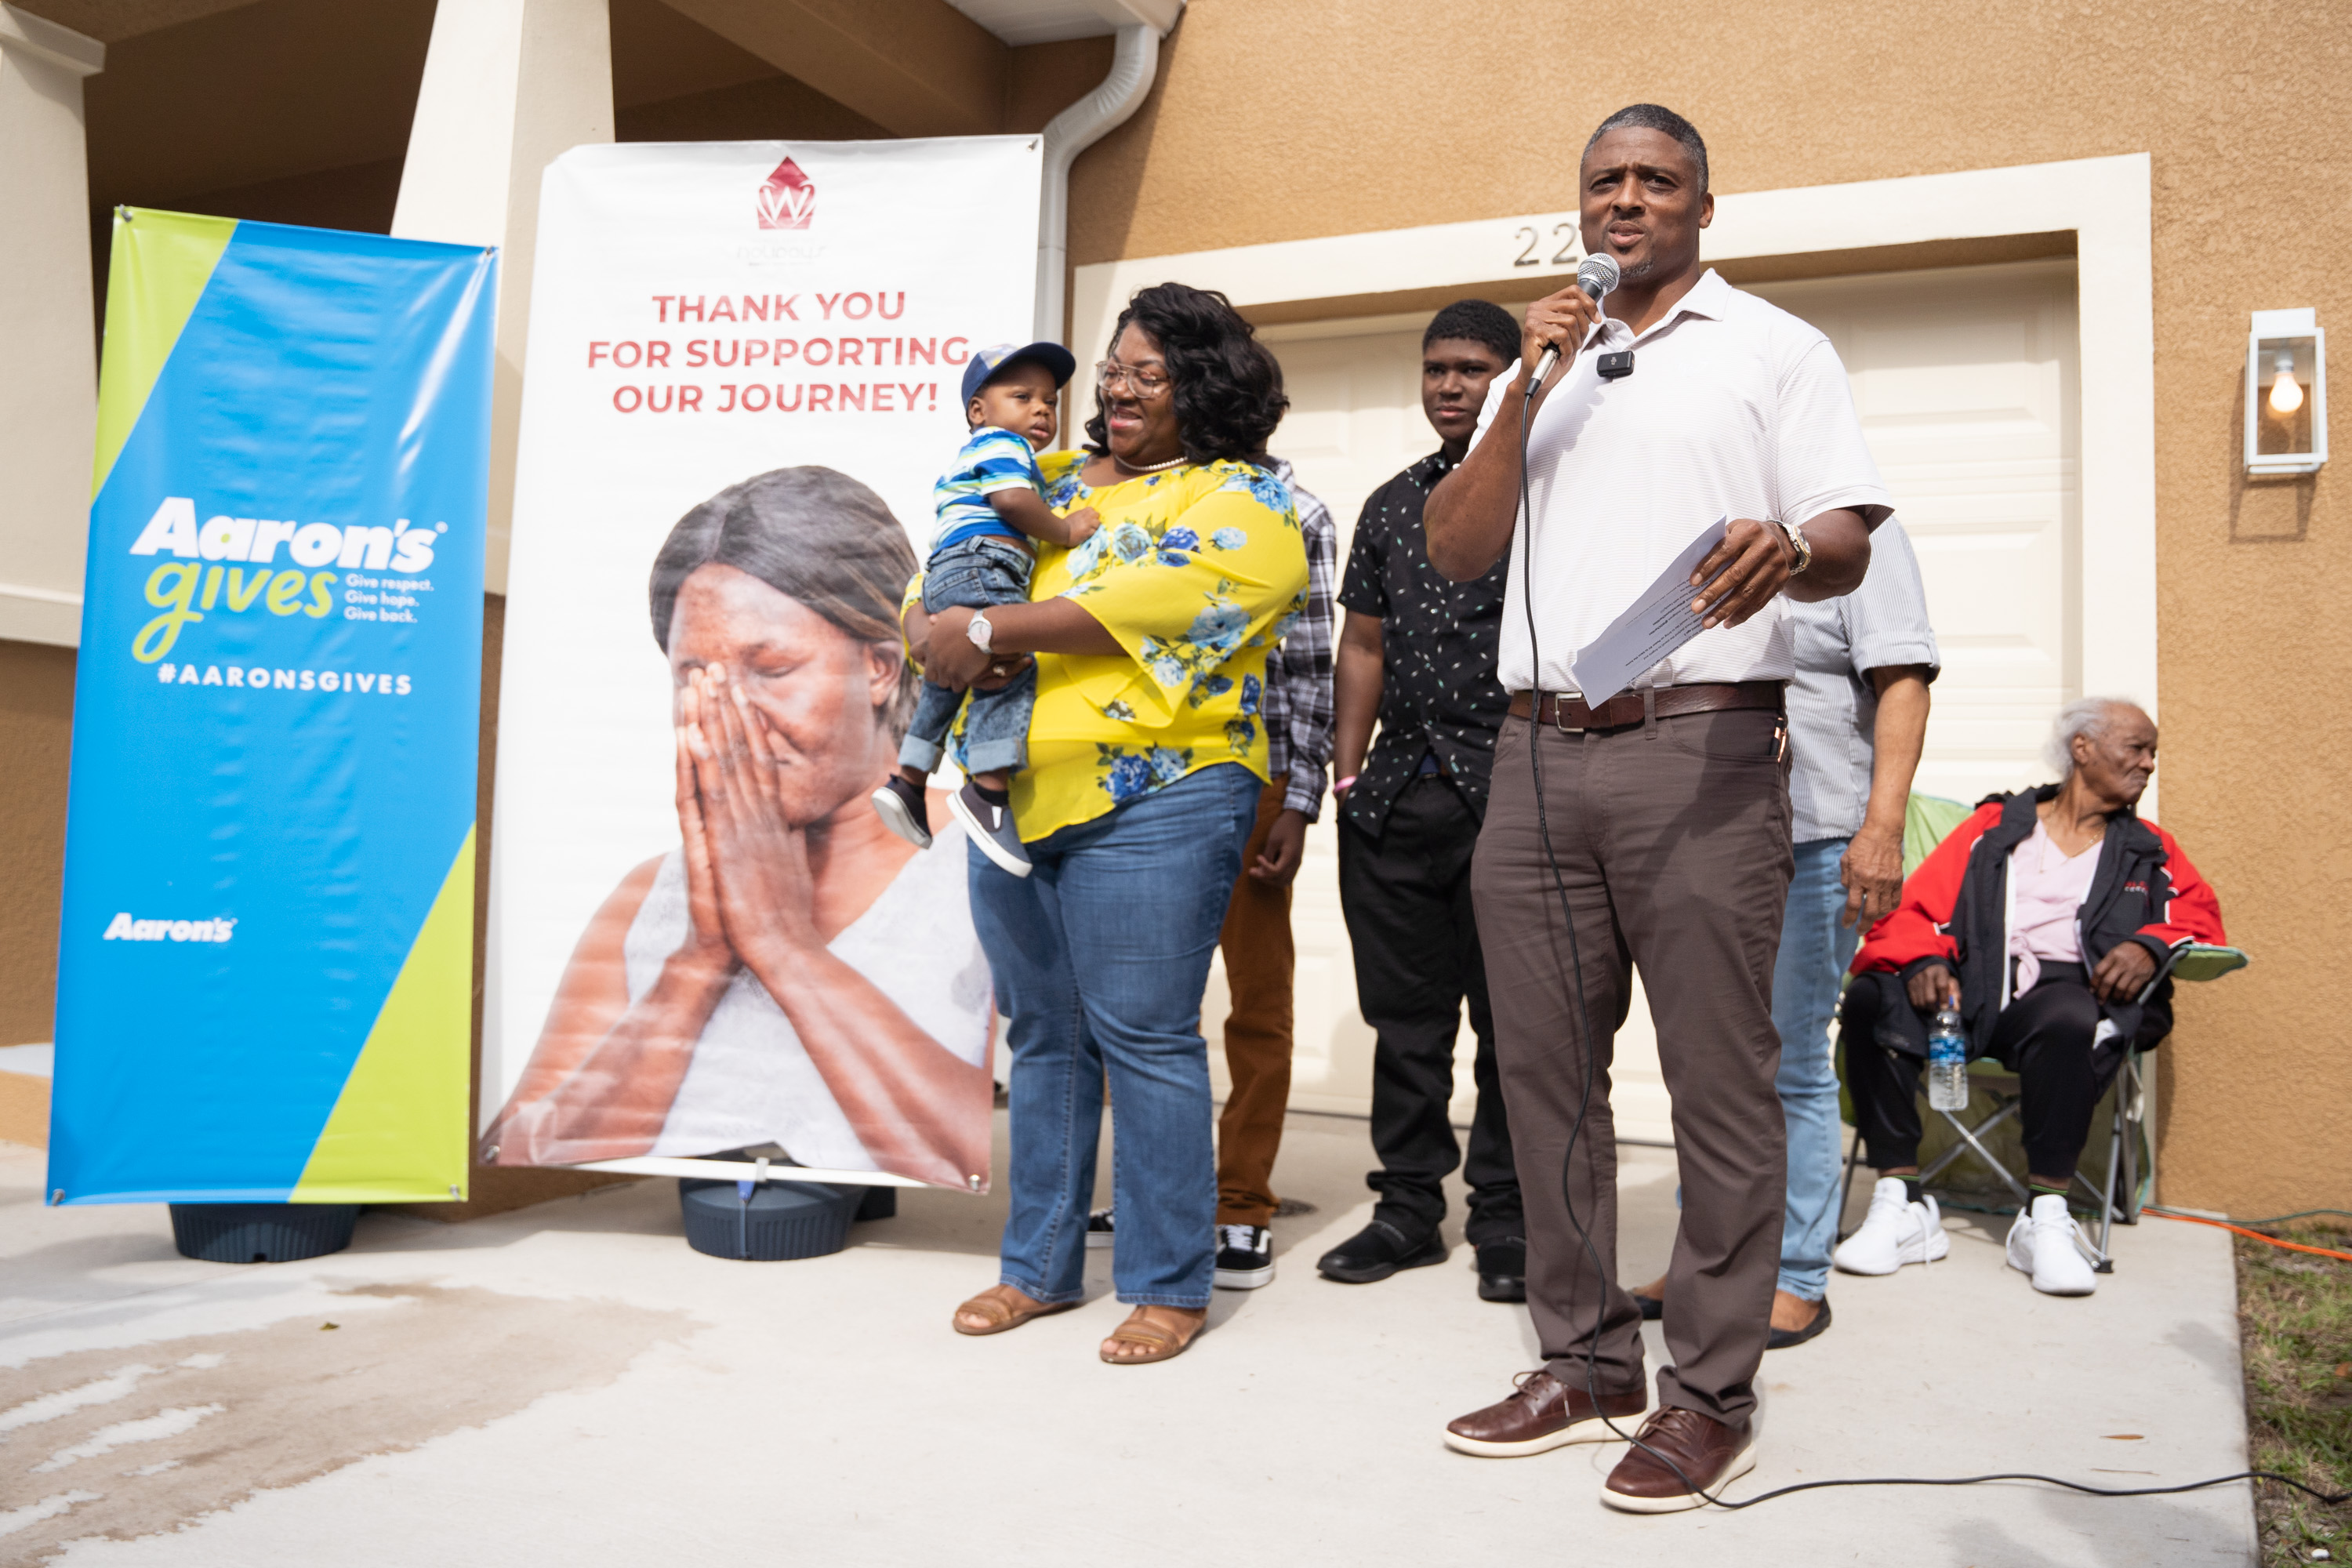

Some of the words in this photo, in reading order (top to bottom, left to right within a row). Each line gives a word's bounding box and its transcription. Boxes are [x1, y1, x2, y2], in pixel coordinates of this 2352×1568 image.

[652, 294, 800, 323] THANK
[815, 291, 906, 321] YOU
[588, 340, 672, 368] FOR
[685, 336, 970, 368] SUPPORTING
[612, 384, 704, 414] OUR
[716, 383, 938, 413] JOURNEY!
[345, 572, 379, 590] Give
[381, 577, 435, 593] respect.
[131, 561, 339, 664] gives
[343, 605, 378, 622] Give
[379, 607, 419, 624] back.
[344, 589, 379, 605] Give
[379, 590, 420, 609] hope.
[158, 662, 412, 696] #AARONSGIVES
